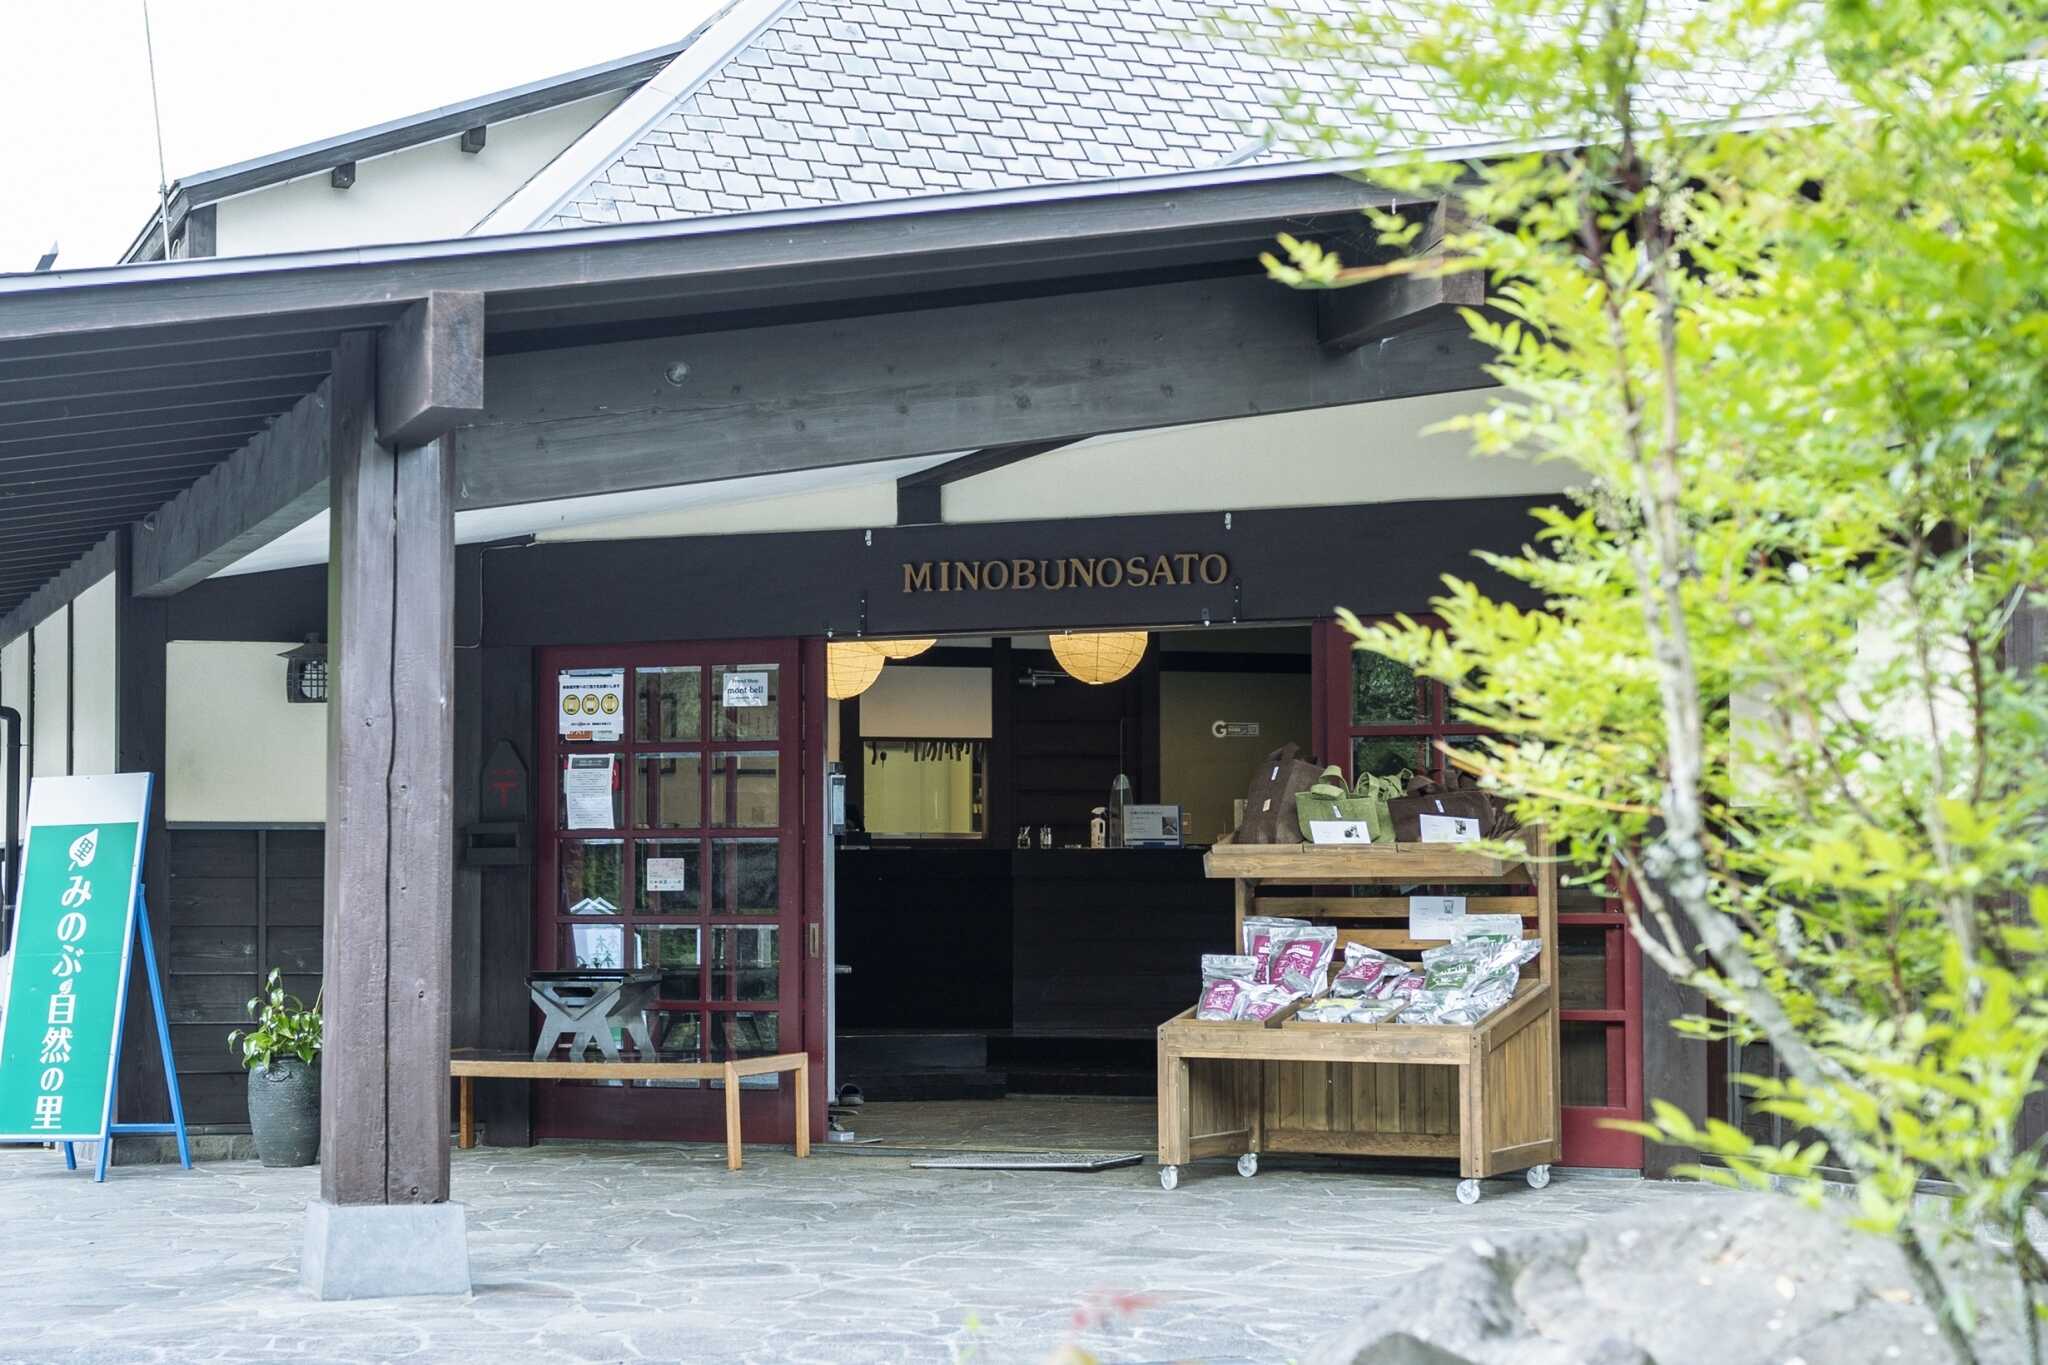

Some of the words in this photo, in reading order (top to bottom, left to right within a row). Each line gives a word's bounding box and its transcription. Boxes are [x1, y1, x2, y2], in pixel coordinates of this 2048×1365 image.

[902, 553, 1228, 593] MINOBUNOSATO
[30, 875, 92, 1130] みのぶ自然の里
